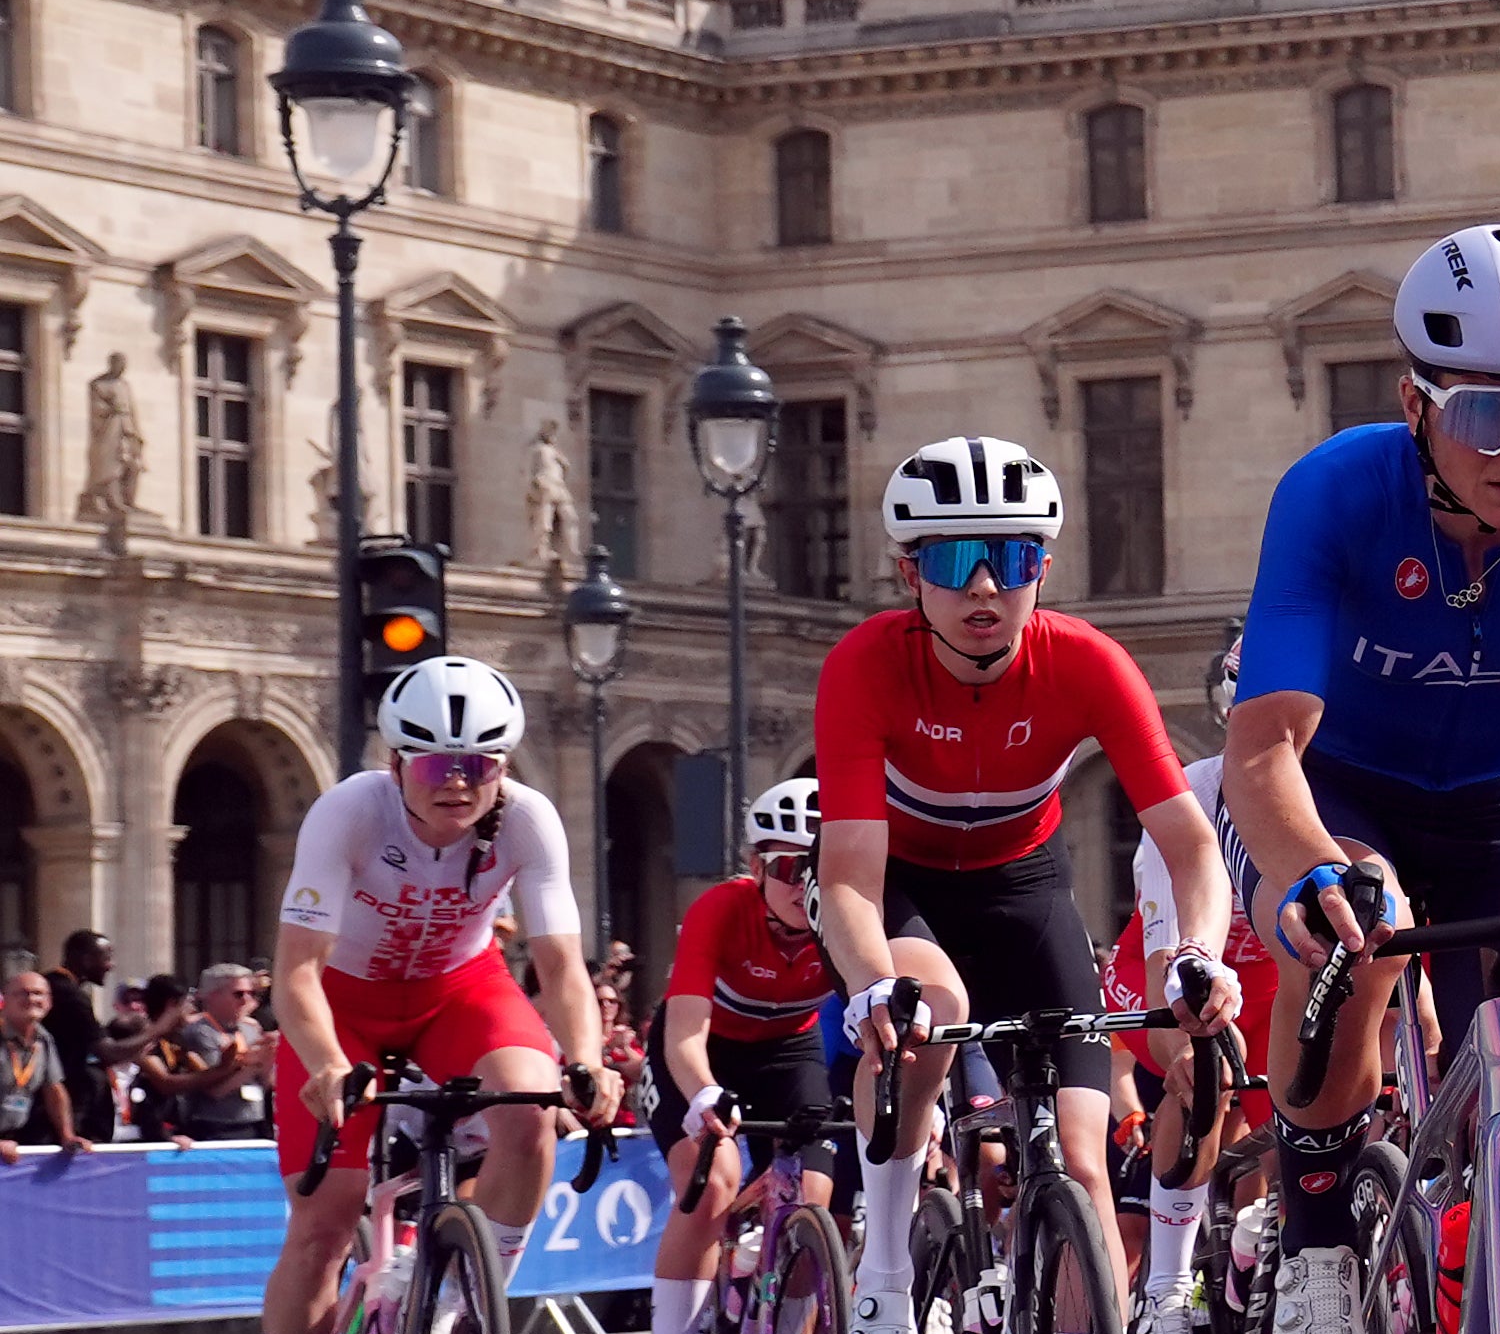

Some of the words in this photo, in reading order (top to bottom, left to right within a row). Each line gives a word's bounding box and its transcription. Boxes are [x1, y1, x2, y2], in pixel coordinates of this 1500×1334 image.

[914, 717, 963, 743] NOR
[1304, 940, 1348, 1023] SRAM
[1274, 1112, 1371, 1151] ITALIA
